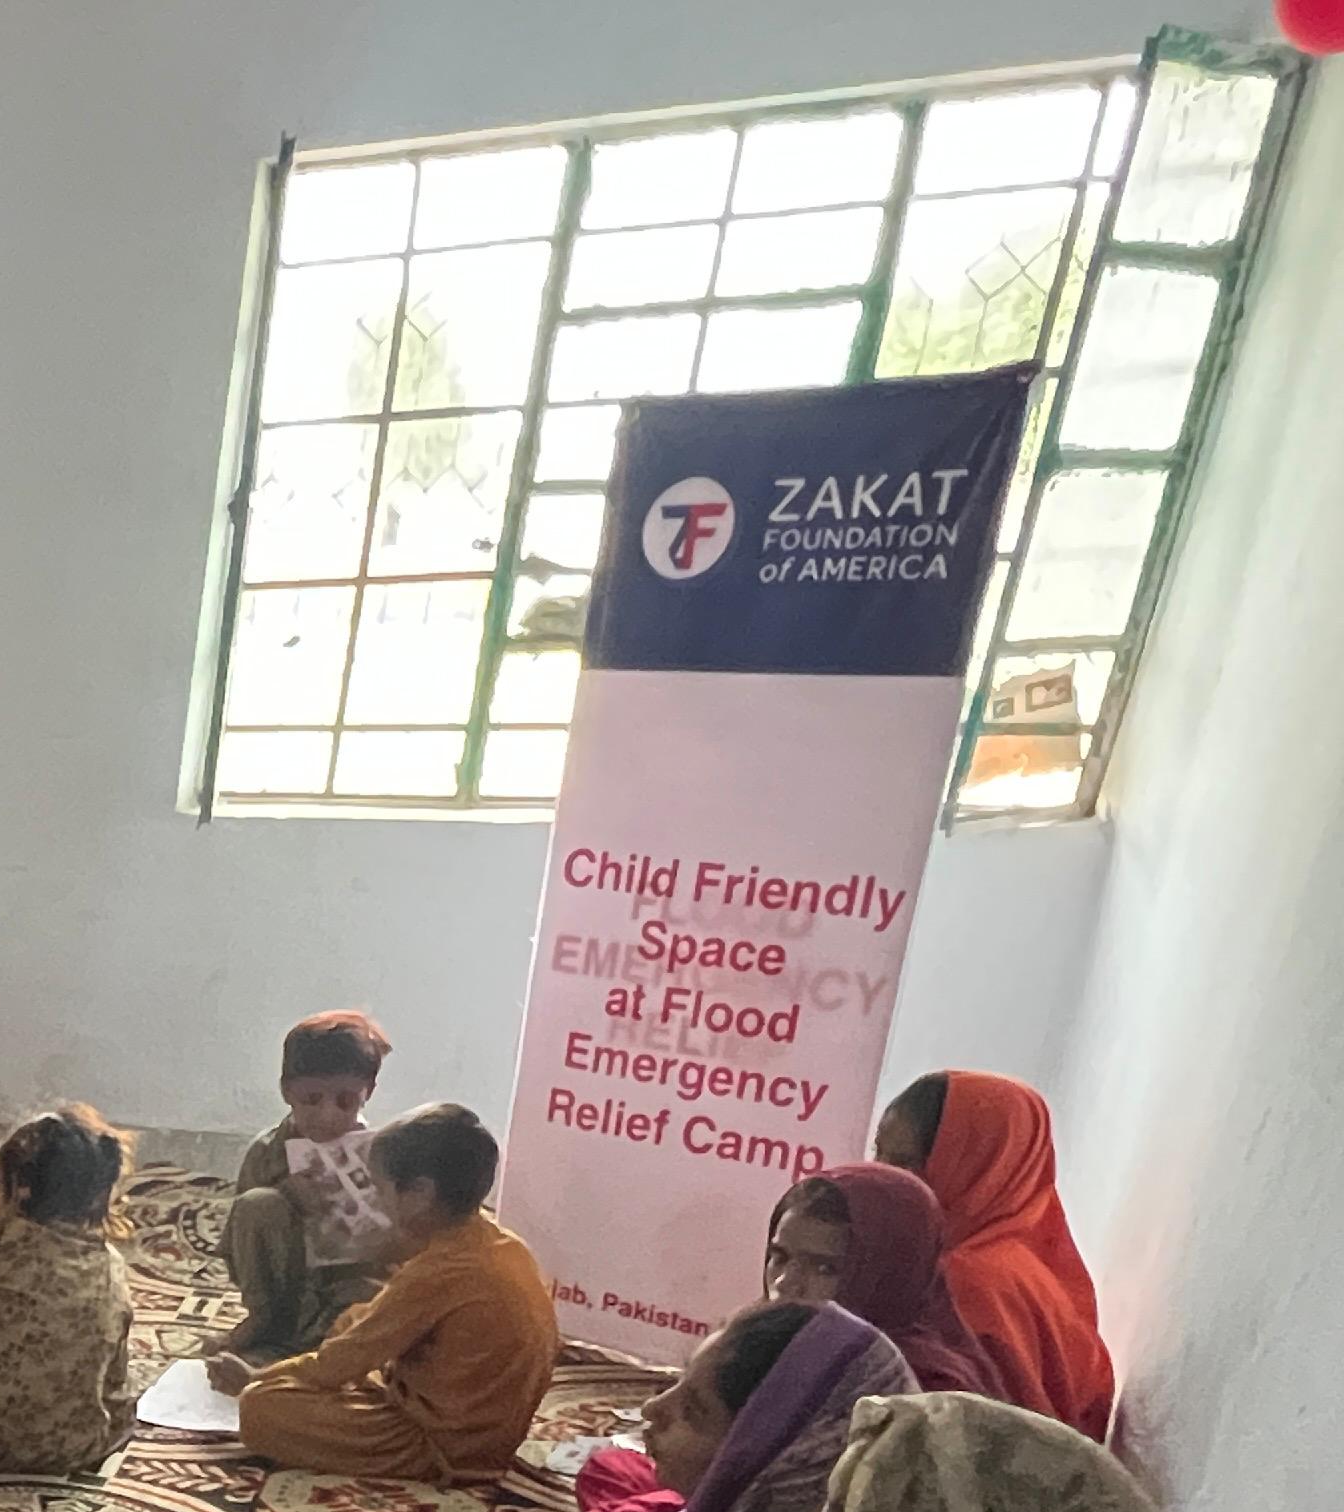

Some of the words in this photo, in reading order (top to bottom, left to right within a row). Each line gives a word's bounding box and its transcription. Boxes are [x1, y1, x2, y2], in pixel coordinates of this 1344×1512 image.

[767, 468, 969, 522] ZAKAT
[763, 523, 959, 552] FOUNDATION
[759, 553, 795, 583] of
[796, 552, 948, 582] AMERICA
[563, 847, 680, 899] Child
[693, 861, 907, 932] Friendly
[636, 919, 787, 976] Space
[604, 985, 643, 1021] at
[660, 987, 800, 1044] Flood
[564, 1031, 830, 1121] Emergency
[547, 1088, 670, 1146] Relief
[682, 1115, 826, 1179] Camp
[601, 1292, 709, 1337] Pakistan
